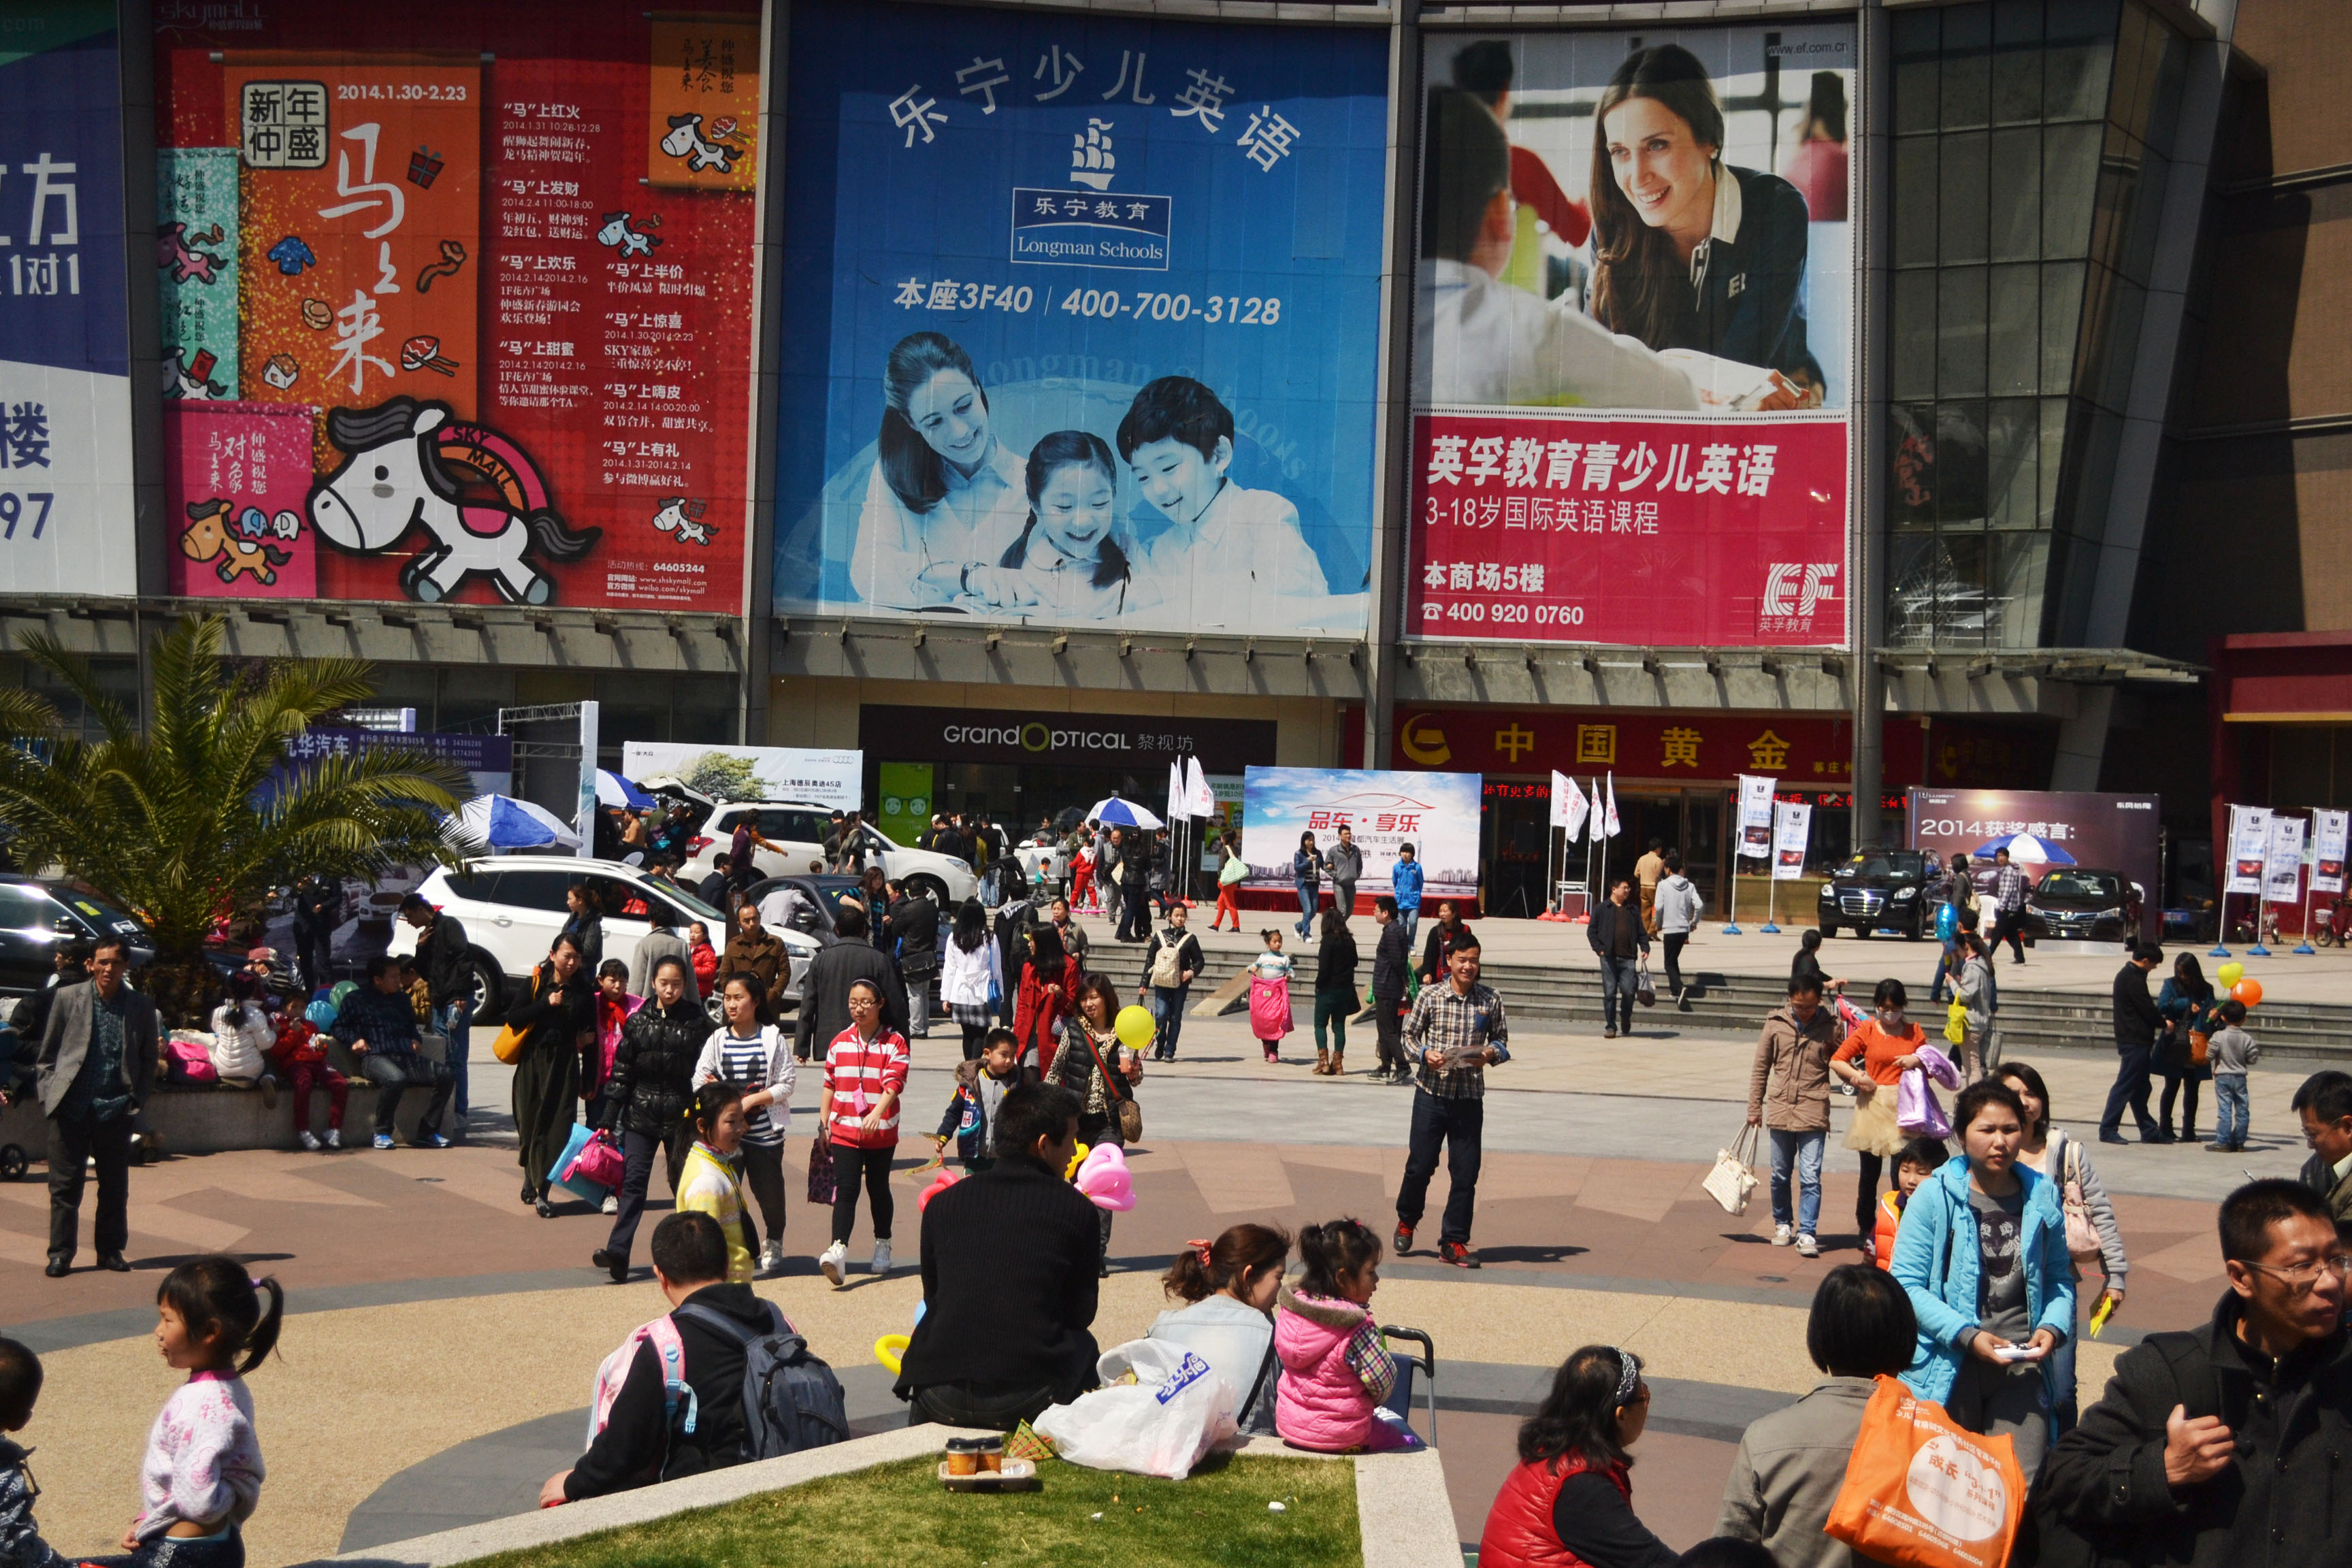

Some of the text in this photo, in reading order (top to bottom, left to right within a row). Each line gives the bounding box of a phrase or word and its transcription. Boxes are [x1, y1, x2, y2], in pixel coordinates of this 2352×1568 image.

[1769, 42, 1848, 54] www.ef.com.cn
[338, 85, 466, 101] 2014.1.30-2.23
[888, 44, 1301, 173] 乐宁少儿英语
[1034, 197, 1150, 220] 乐宁教育
[1017, 236, 1163, 260] Longman Schools
[894, 277, 1281, 325] 本座3F40 400-700-3128
[987, 353, 1152, 389] ongman
[454, 427, 491, 444] SKY
[208, 431, 223, 492] 马上来
[222, 434, 246, 495] 对象
[251, 432, 267, 495] 仲盛祝您
[467, 448, 513, 490] MALL
[1427, 435, 1778, 497] 英孚教育青少儿英语
[0, 492, 54, 540] 97
[1425, 495, 1659, 536] 3-18岁国际英语课程
[653, 563, 705, 573] 64605244
[1423, 561, 1545, 593] 本商场5楼
[1761, 562, 1838, 617] EF
[1447, 602, 1583, 625] 400 920 0760
[1759, 617, 1812, 634] 英孚教育
[1138, 734, 1193, 751] 黎视坊
[1495, 723, 1791, 770] 中国黄金
[1929, 1454, 1959, 1480] 成长
